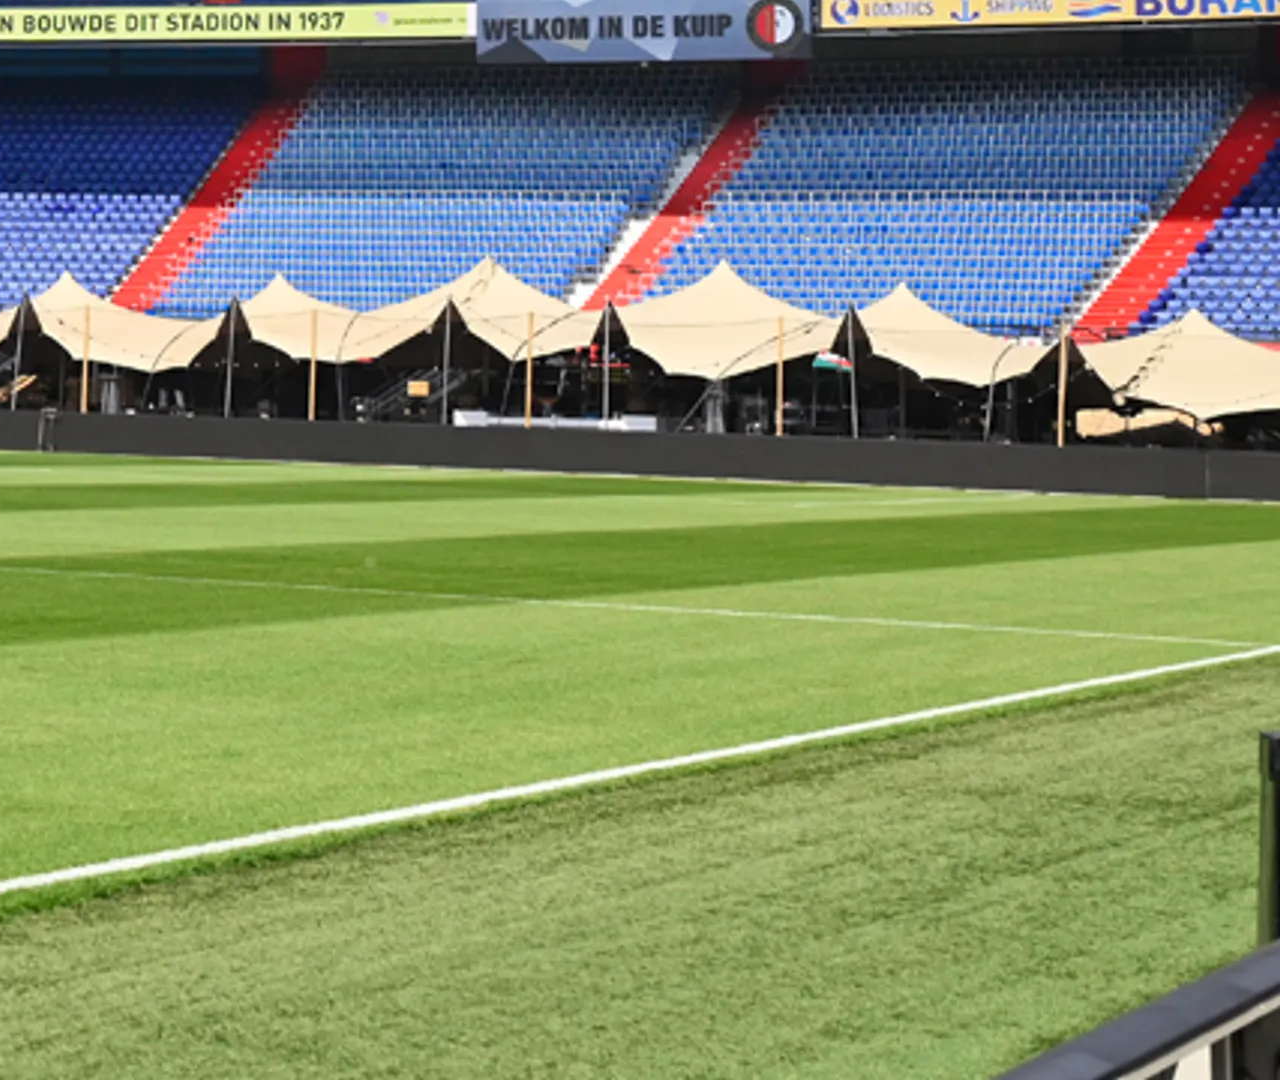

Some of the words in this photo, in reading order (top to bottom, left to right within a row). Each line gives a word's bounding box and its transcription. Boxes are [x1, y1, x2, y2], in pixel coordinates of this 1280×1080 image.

[864, 0, 934, 17] LOGISTICS
[22, 14, 117, 34] BOUWDE
[125, 13, 159, 33] DIT
[166, 12, 261, 32] STADION
[268, 12, 292, 32] IN
[299, 11, 345, 31] 1937
[482, 16, 590, 40] WELKOM
[598, 16, 623, 39] IN
[632, 15, 664, 38] DE
[673, 14, 733, 38] KUIP
